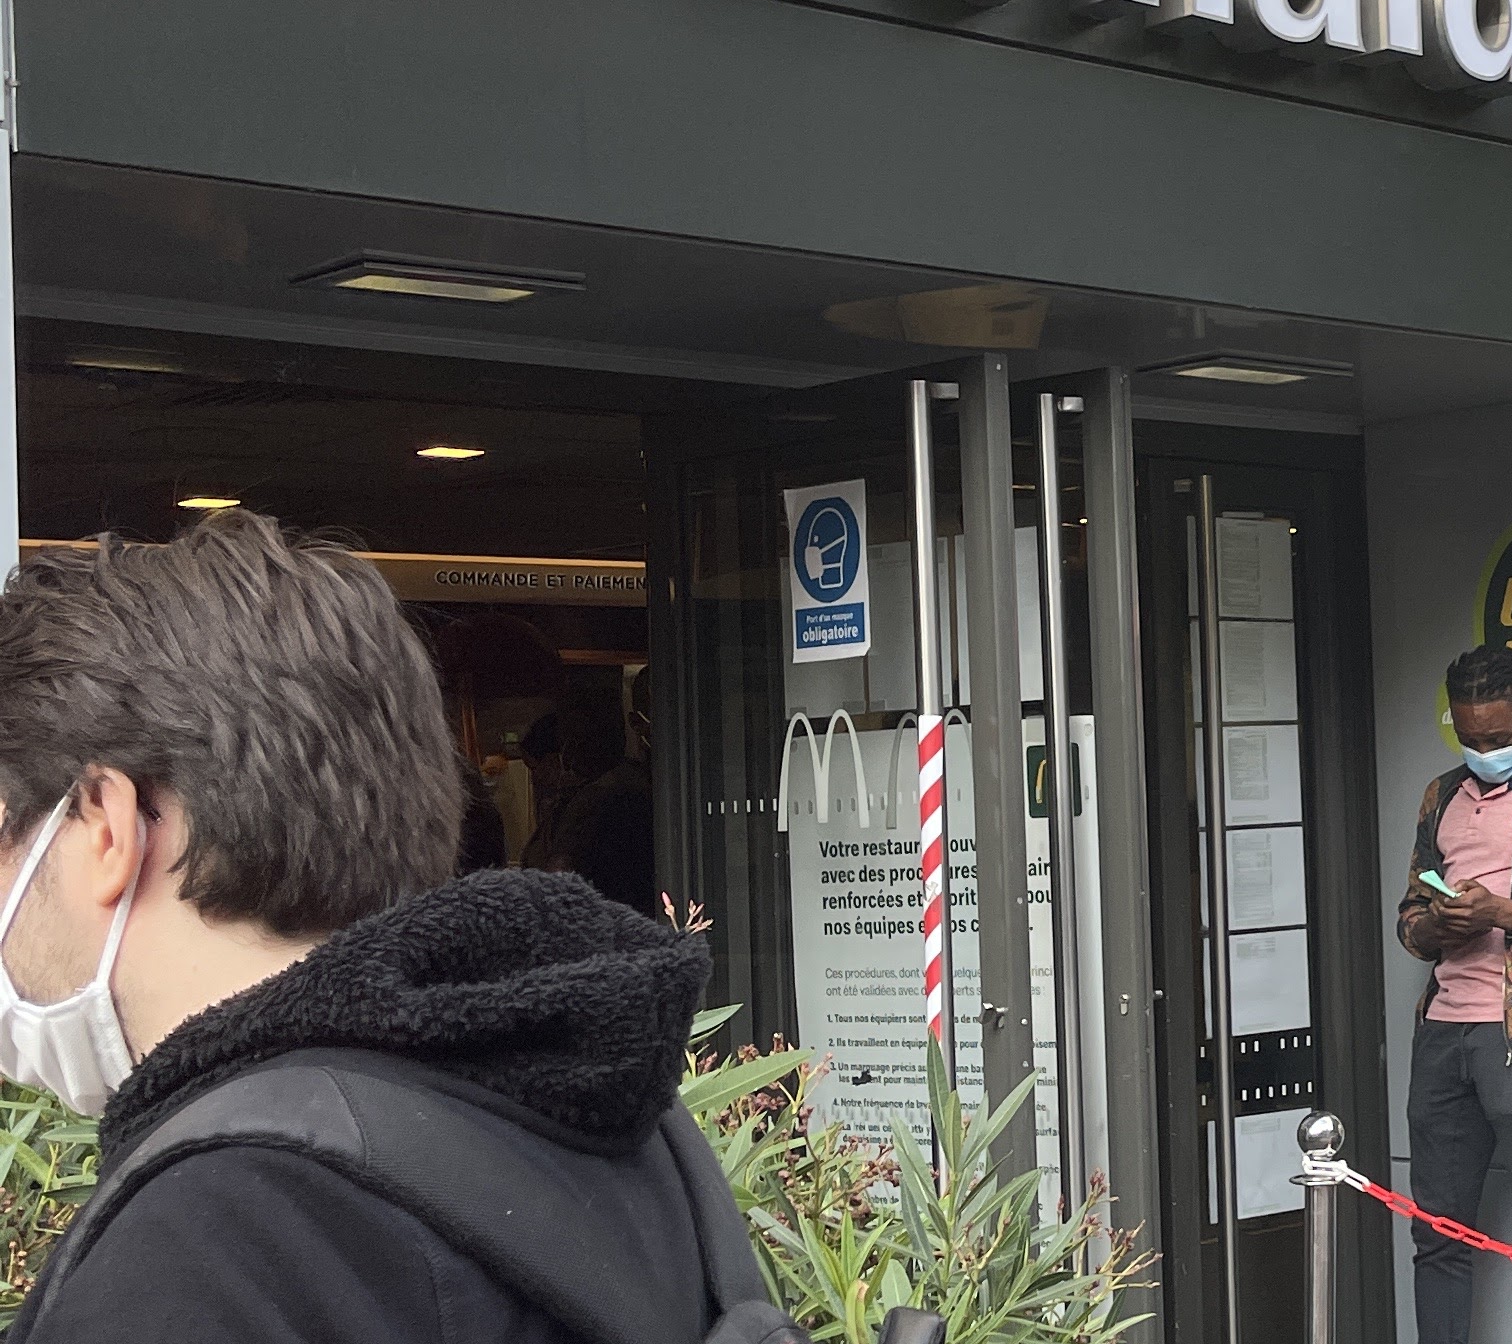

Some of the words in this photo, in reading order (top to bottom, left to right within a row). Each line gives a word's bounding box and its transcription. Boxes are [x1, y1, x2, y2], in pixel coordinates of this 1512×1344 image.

[435, 570, 539, 588] COMMANDE
[545, 573, 566, 588] ET
[573, 575, 646, 590] PAIEMEN
[802, 623, 859, 645] obligatoire
[819, 838, 859, 858] Votre
[863, 837, 922, 857] restaur
[821, 866, 855, 884] avec
[858, 863, 886, 883] des
[822, 888, 904, 910] renforcées
[907, 891, 923, 907] et
[824, 919, 851, 936] nos
[854, 914, 914, 939] équipes
[825, 967, 842, 979] Ces
[844, 967, 898, 981] procédures,
[898, 967, 920, 979] dont
[825, 986, 841, 997] ont
[843, 984, 857, 997] été
[860, 984, 897, 997] validées
[898, 987, 920, 997] avec
[834, 1014, 853, 1023] Tous
[854, 1015, 869, 1023] nos
[870, 1013, 907, 1025] équipiers
[908, 1014, 927, 1023] sont
[890, 1039, 900, 1047] en
[901, 1037, 928, 1050] équipe
